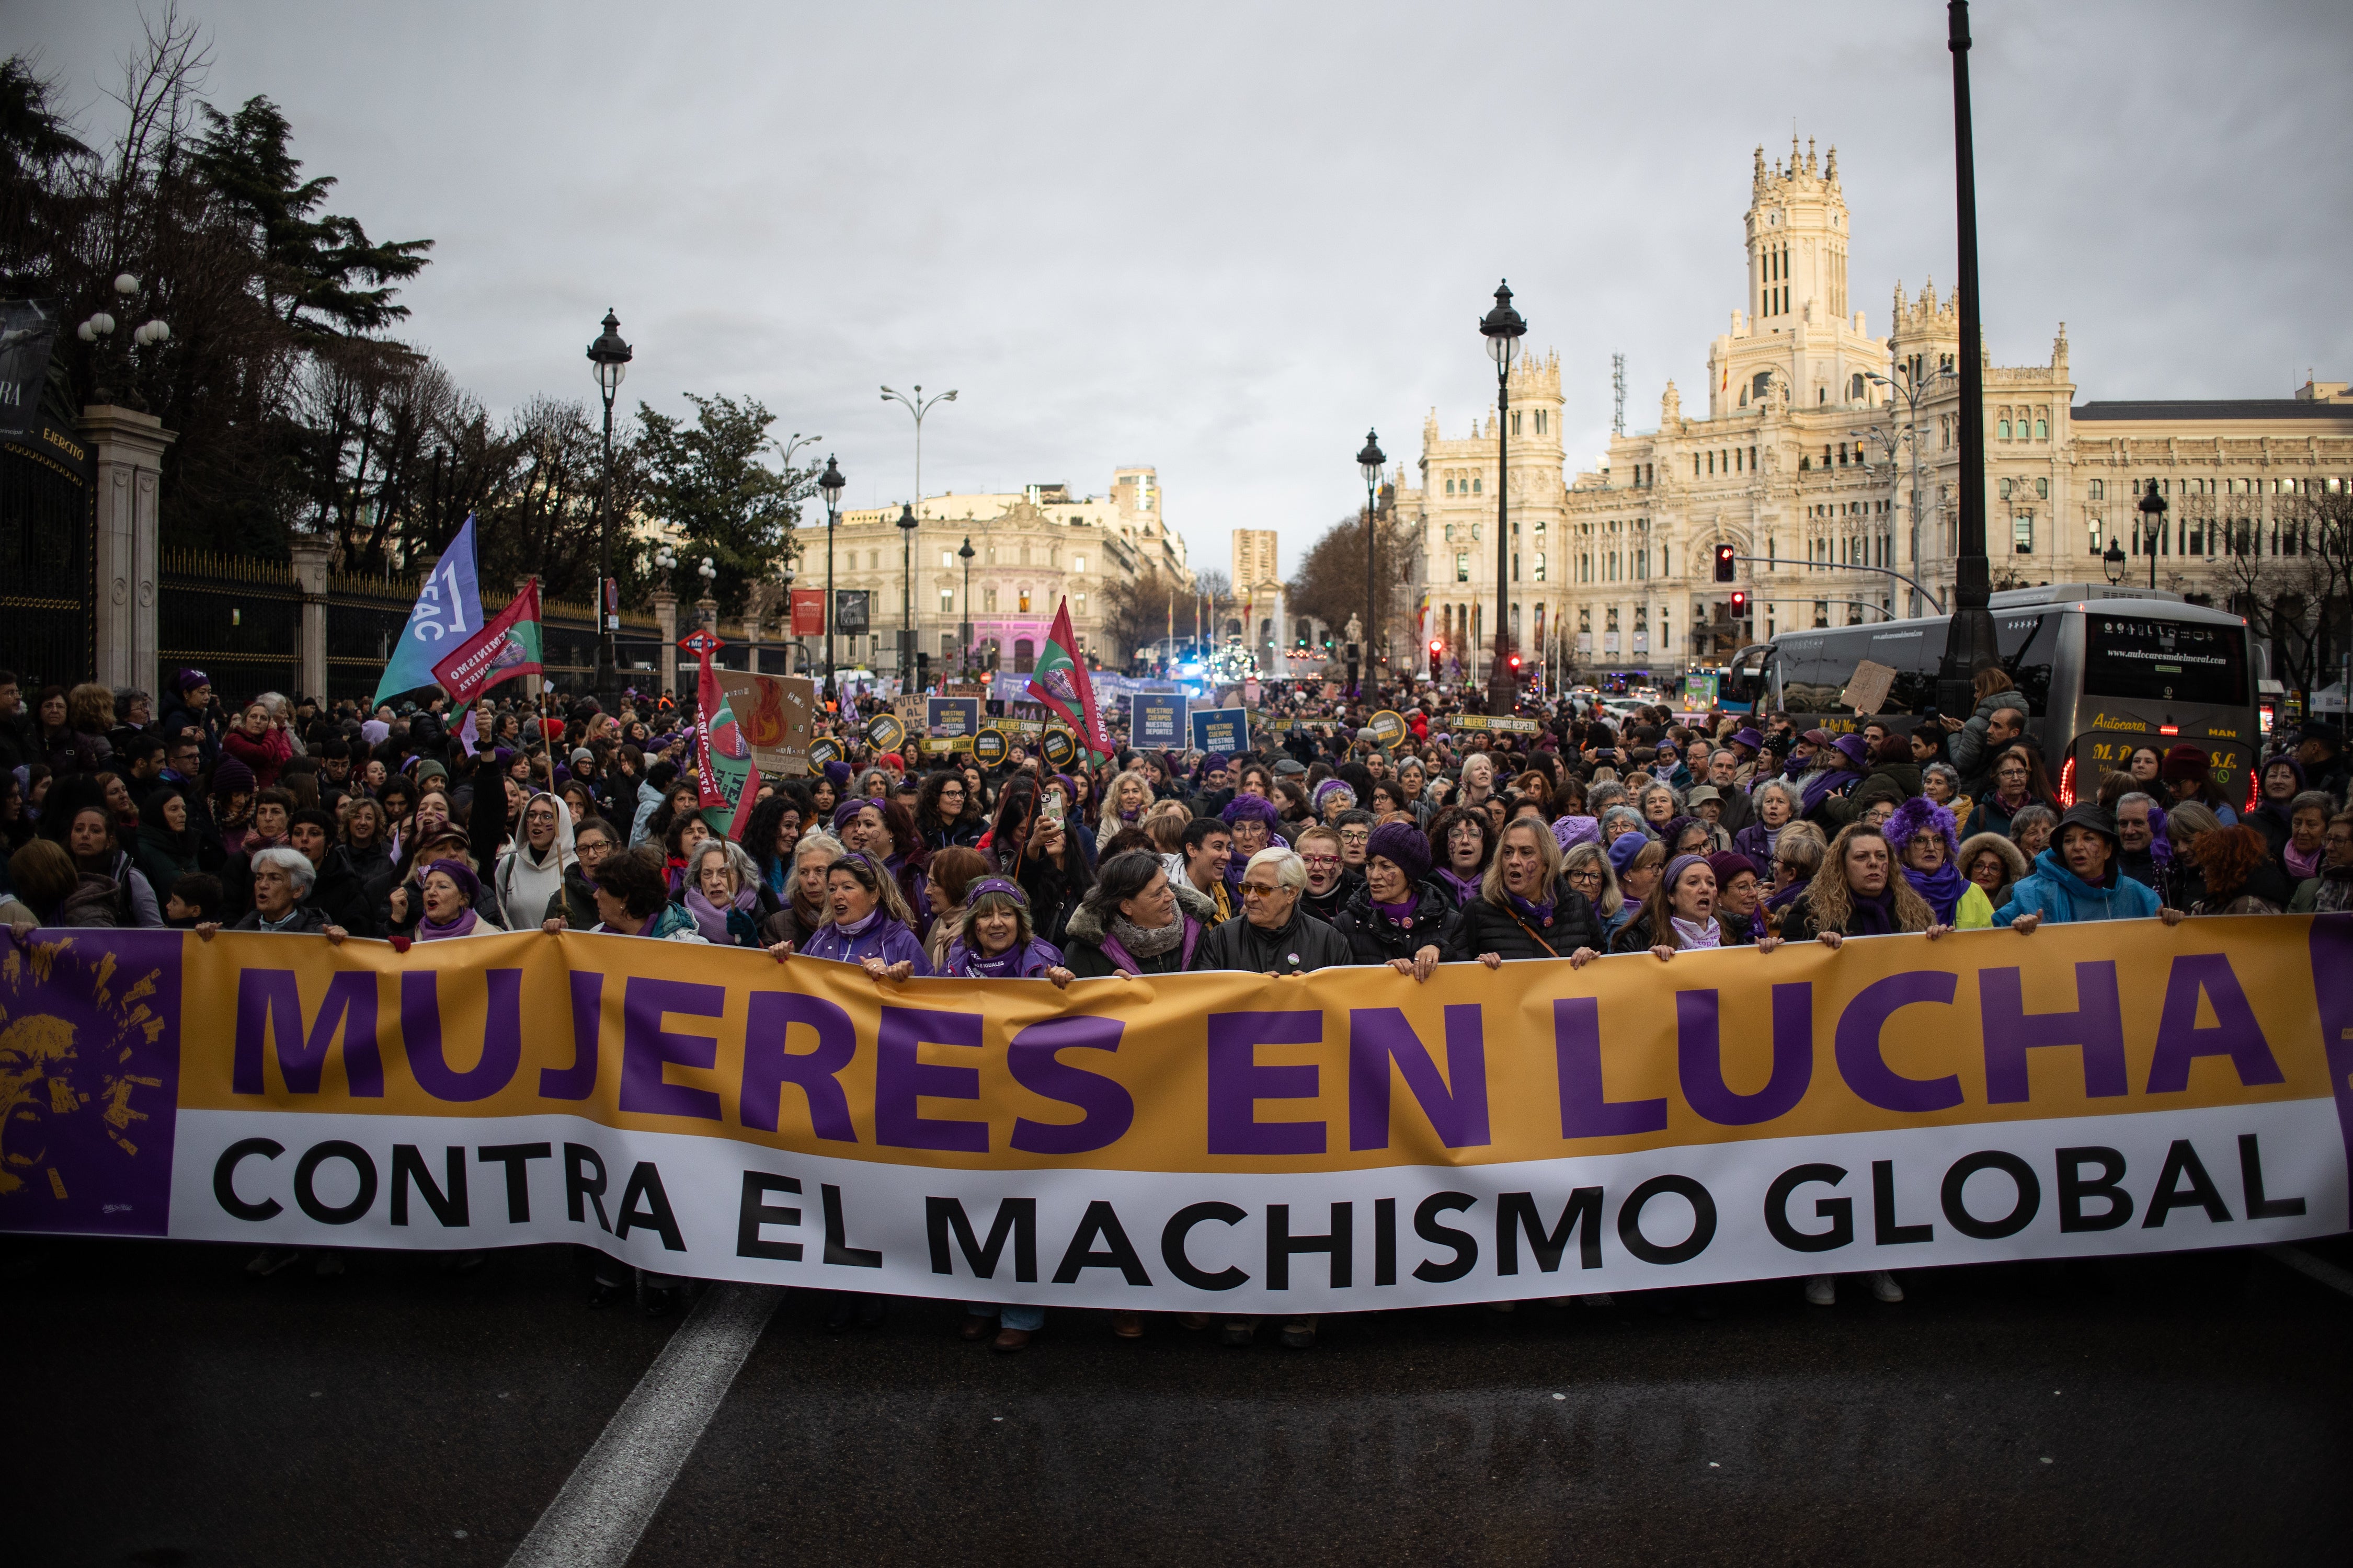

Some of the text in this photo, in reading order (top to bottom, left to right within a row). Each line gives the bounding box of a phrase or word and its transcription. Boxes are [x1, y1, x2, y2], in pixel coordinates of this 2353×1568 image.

[43, 427, 84, 461] EJERCITO
[2107, 649, 2226, 665] www.autocaresmdelmoral.com
[1059, 668, 1077, 700] ABOLICIONISTA
[907, 707, 921, 717] AL
[900, 717, 927, 730] ALDE
[987, 720, 997, 729] LAS
[998, 720, 1020, 730] MUJERES
[1020, 722, 1043, 731] EXIGIMOS
[1453, 716, 1536, 731] LAS MUJERES EXIGIMOS RESPETO
[2092, 713, 2146, 731] Autocares
[2208, 728, 2236, 738] MAN
[922, 741, 931, 750] LAS
[1049, 746, 1069, 759] MUJERES
[1208, 744, 1235, 752] DEPORTES
[2092, 743, 2112, 760] M.
[233, 952, 2285, 1154] MUJERES EN LUCHA
[213, 1133, 2307, 1291] CONTRA EL MACHISMO GLOBAL
